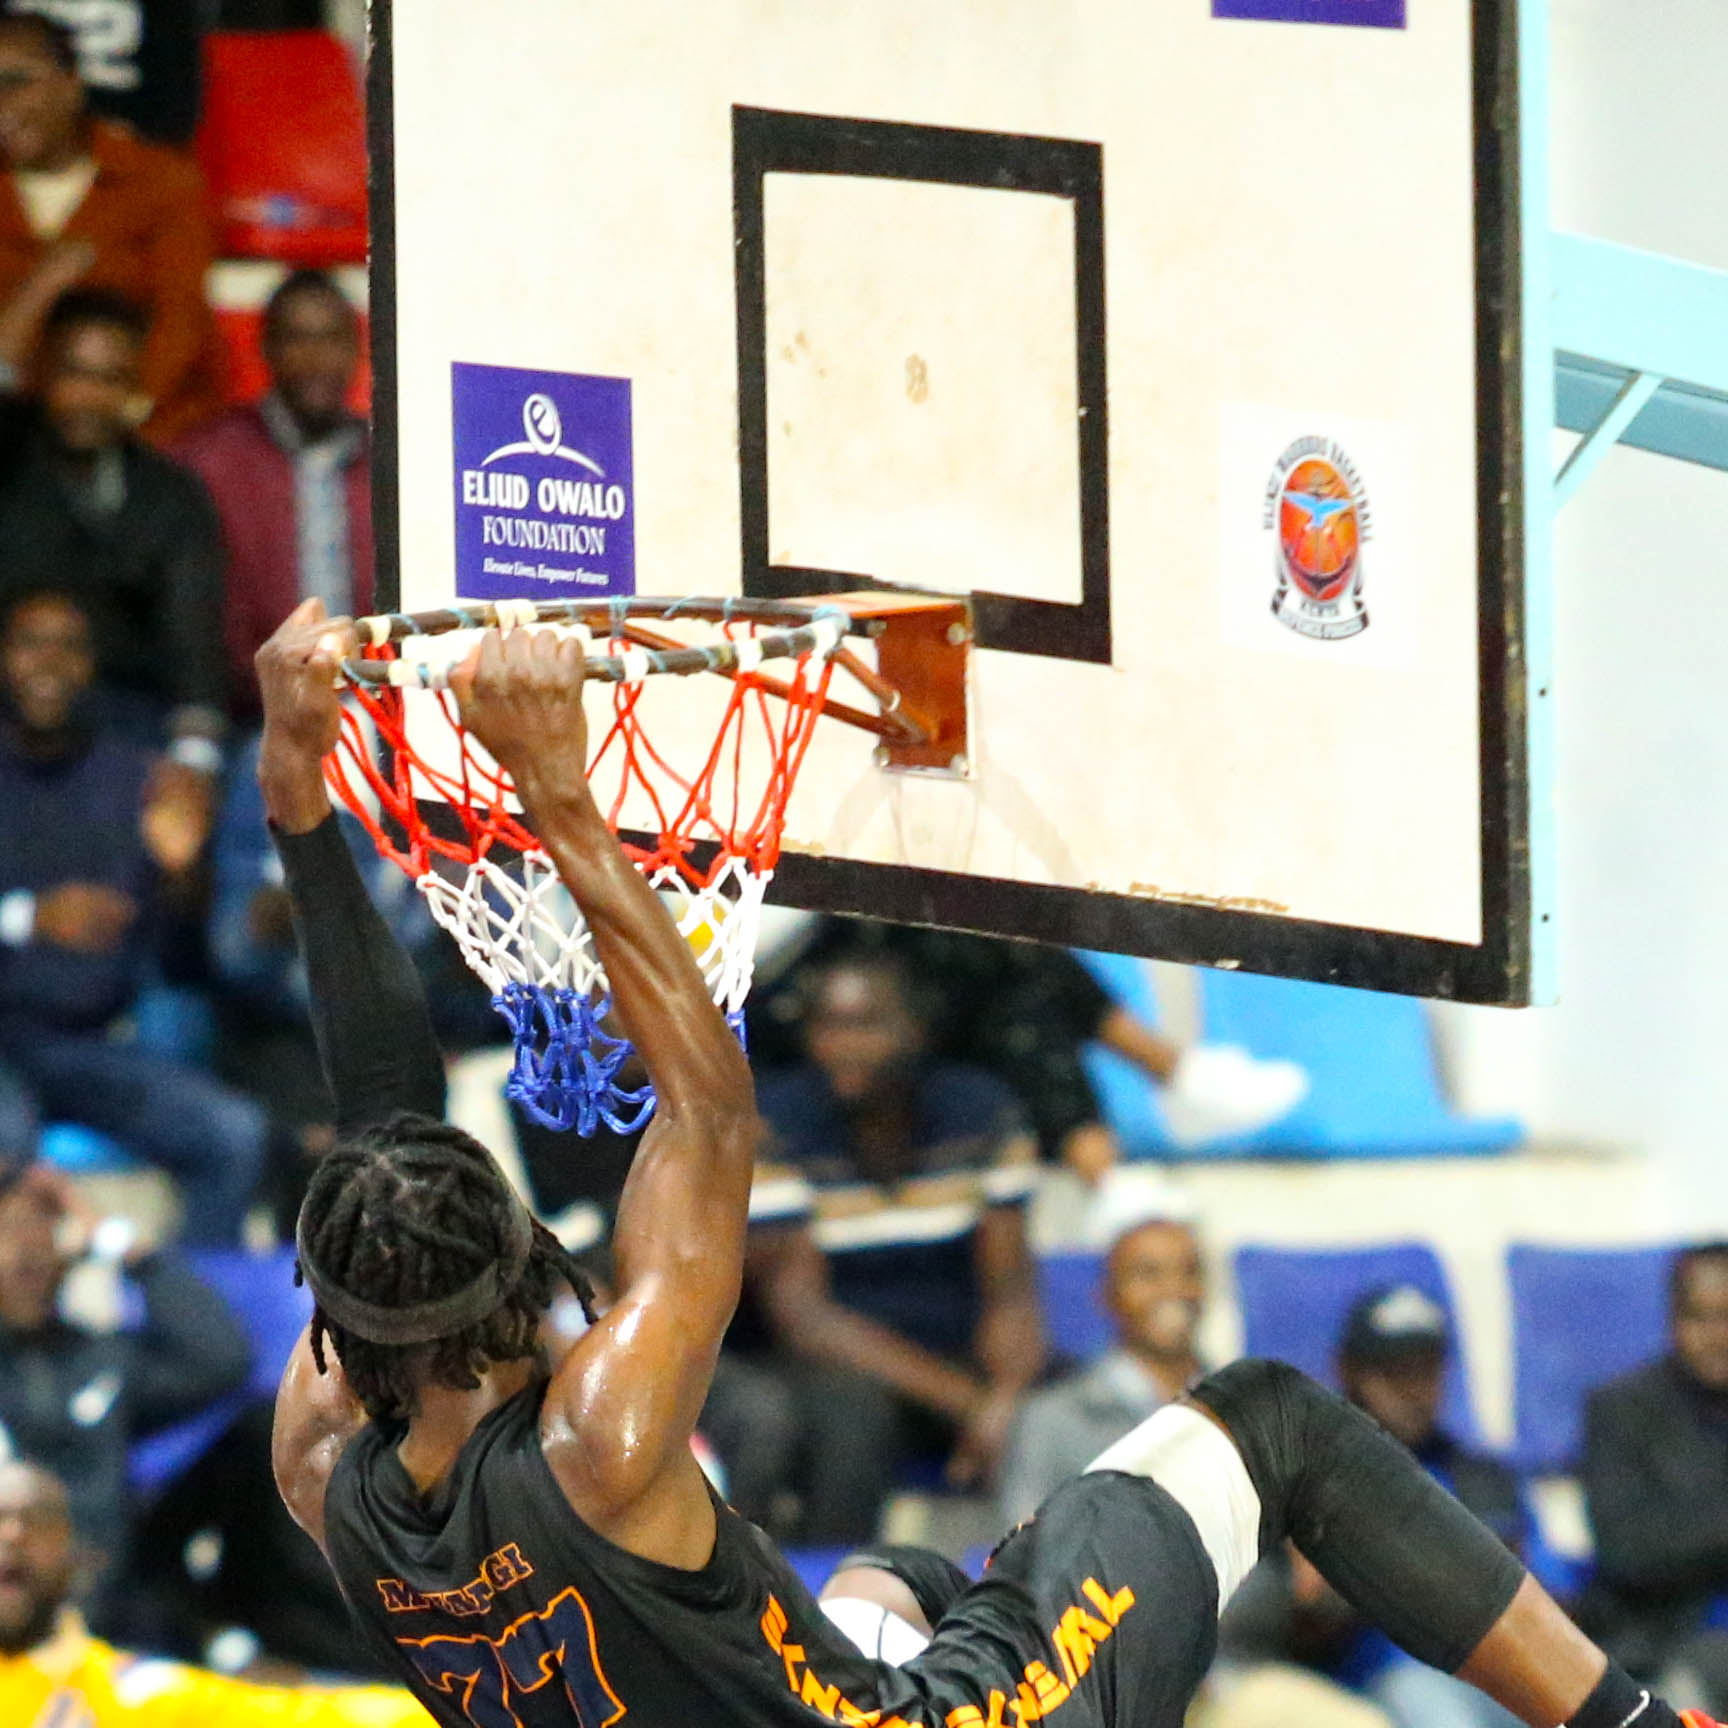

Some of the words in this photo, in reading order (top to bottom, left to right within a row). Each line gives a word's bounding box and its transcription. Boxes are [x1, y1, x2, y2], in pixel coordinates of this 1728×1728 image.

[462, 469, 530, 510] ELIUD
[537, 477, 626, 520] OWALO
[482, 514, 606, 556] FOUNDATION
